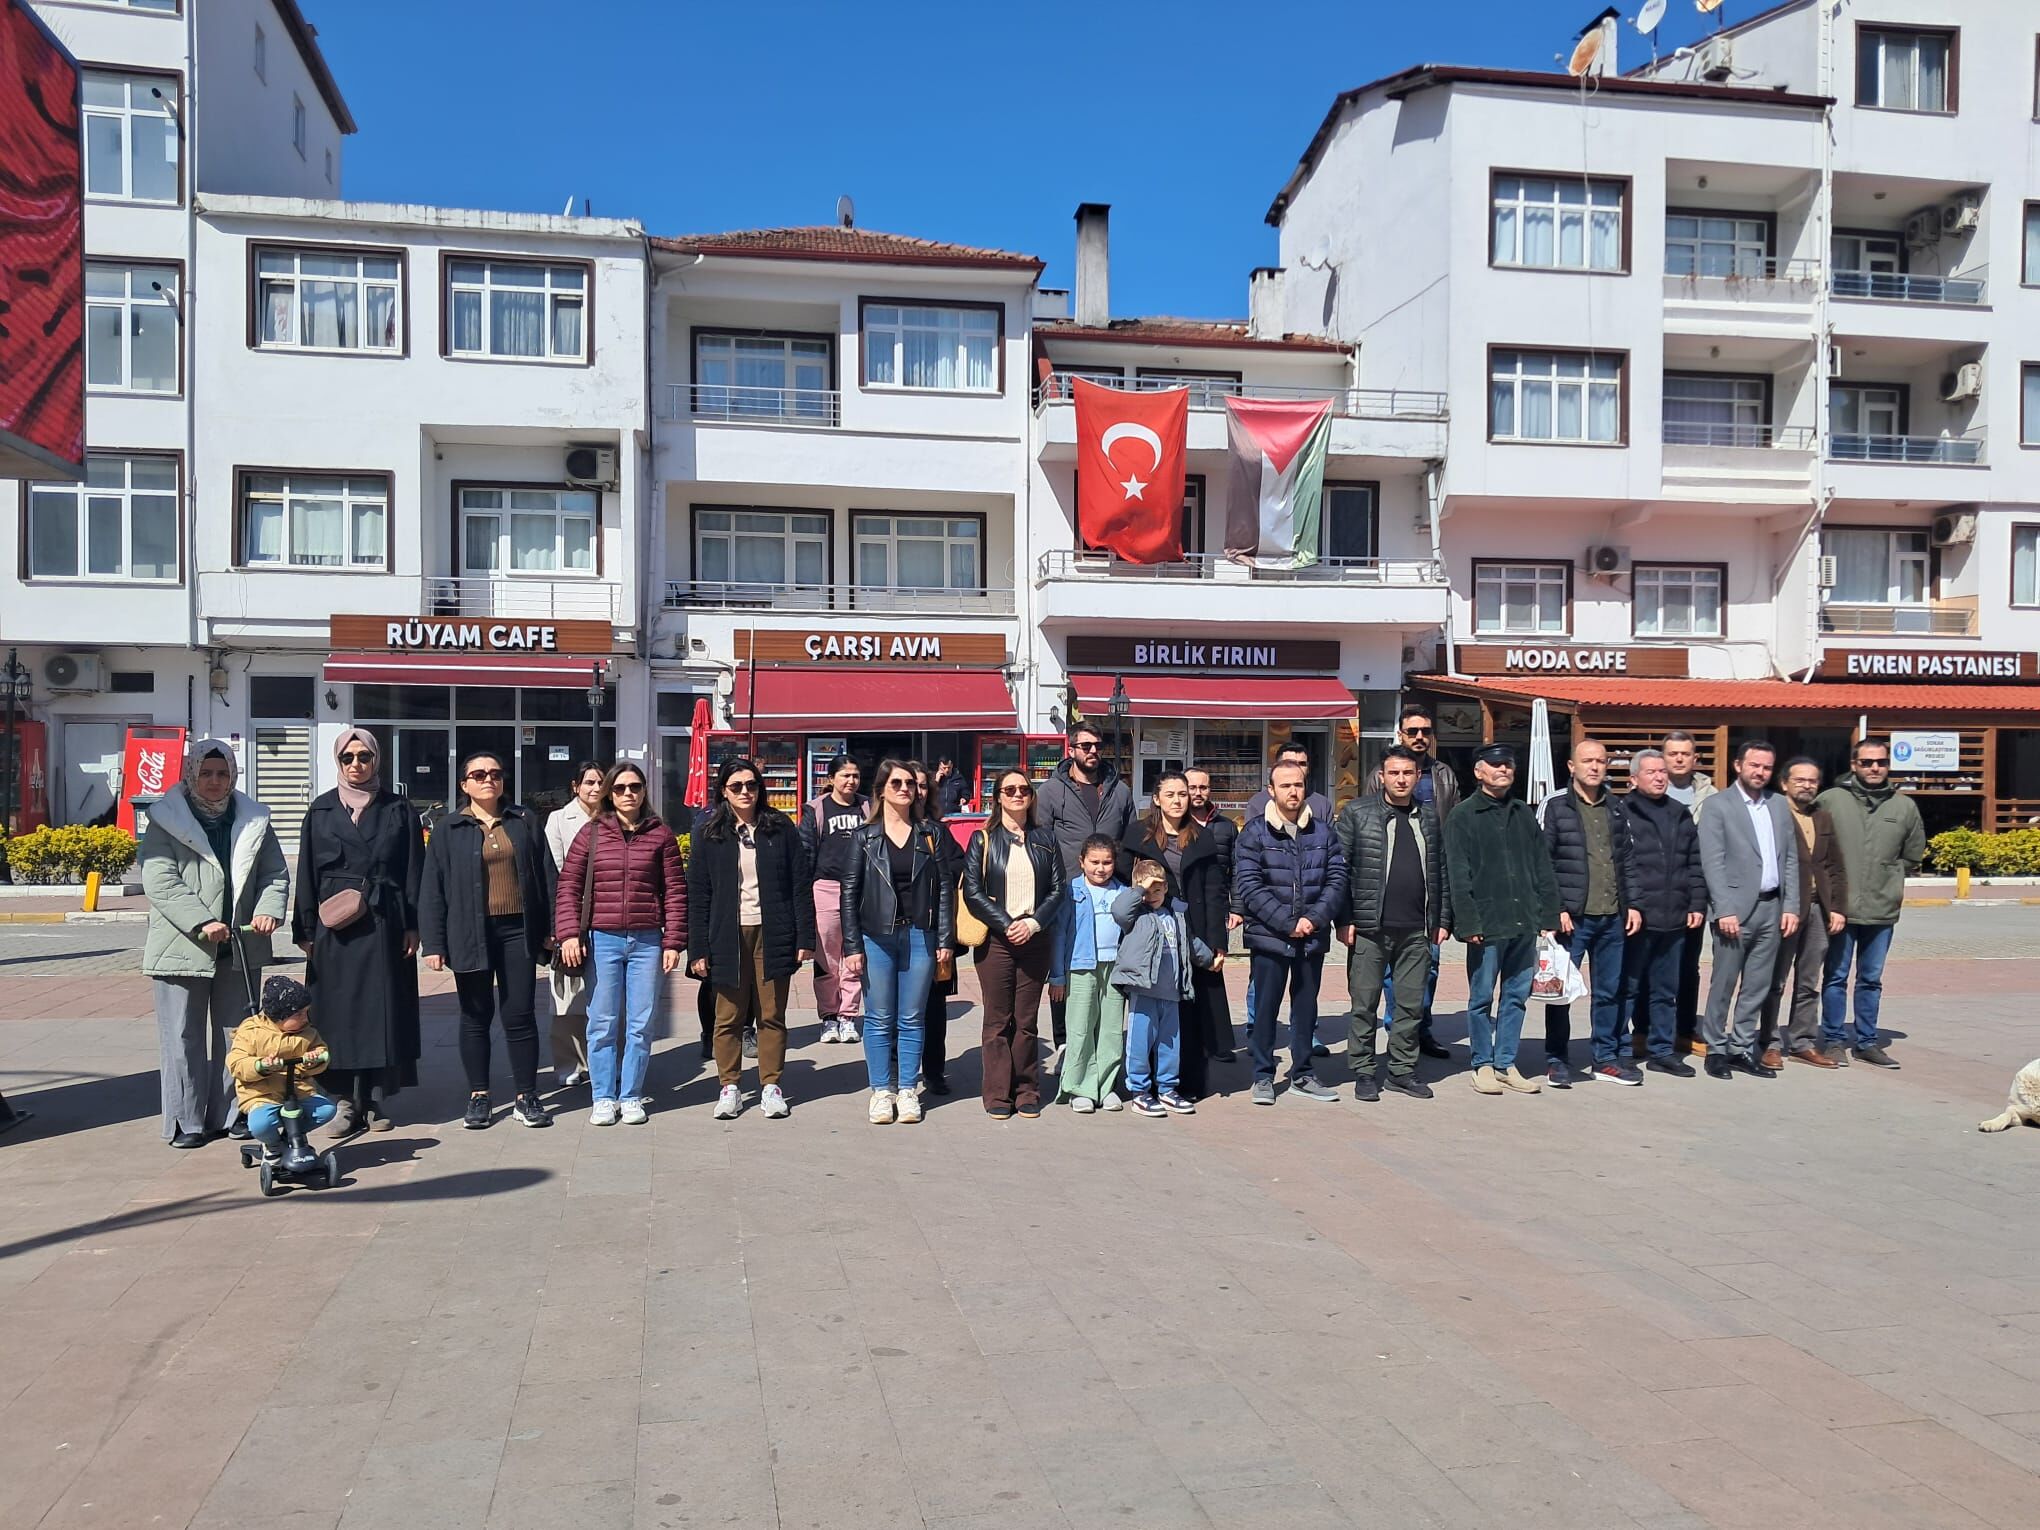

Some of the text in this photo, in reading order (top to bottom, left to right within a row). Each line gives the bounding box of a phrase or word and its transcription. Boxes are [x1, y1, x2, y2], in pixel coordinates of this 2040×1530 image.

[386, 618, 556, 649] RÜYAM CAFE
[804, 635, 941, 660] ÇARŞI AVM
[1134, 640, 1276, 666] BİRLİK FIRINI
[1505, 649, 1627, 671] MODA CAFE
[1847, 652, 2021, 677] EVREN PASTANESİ
